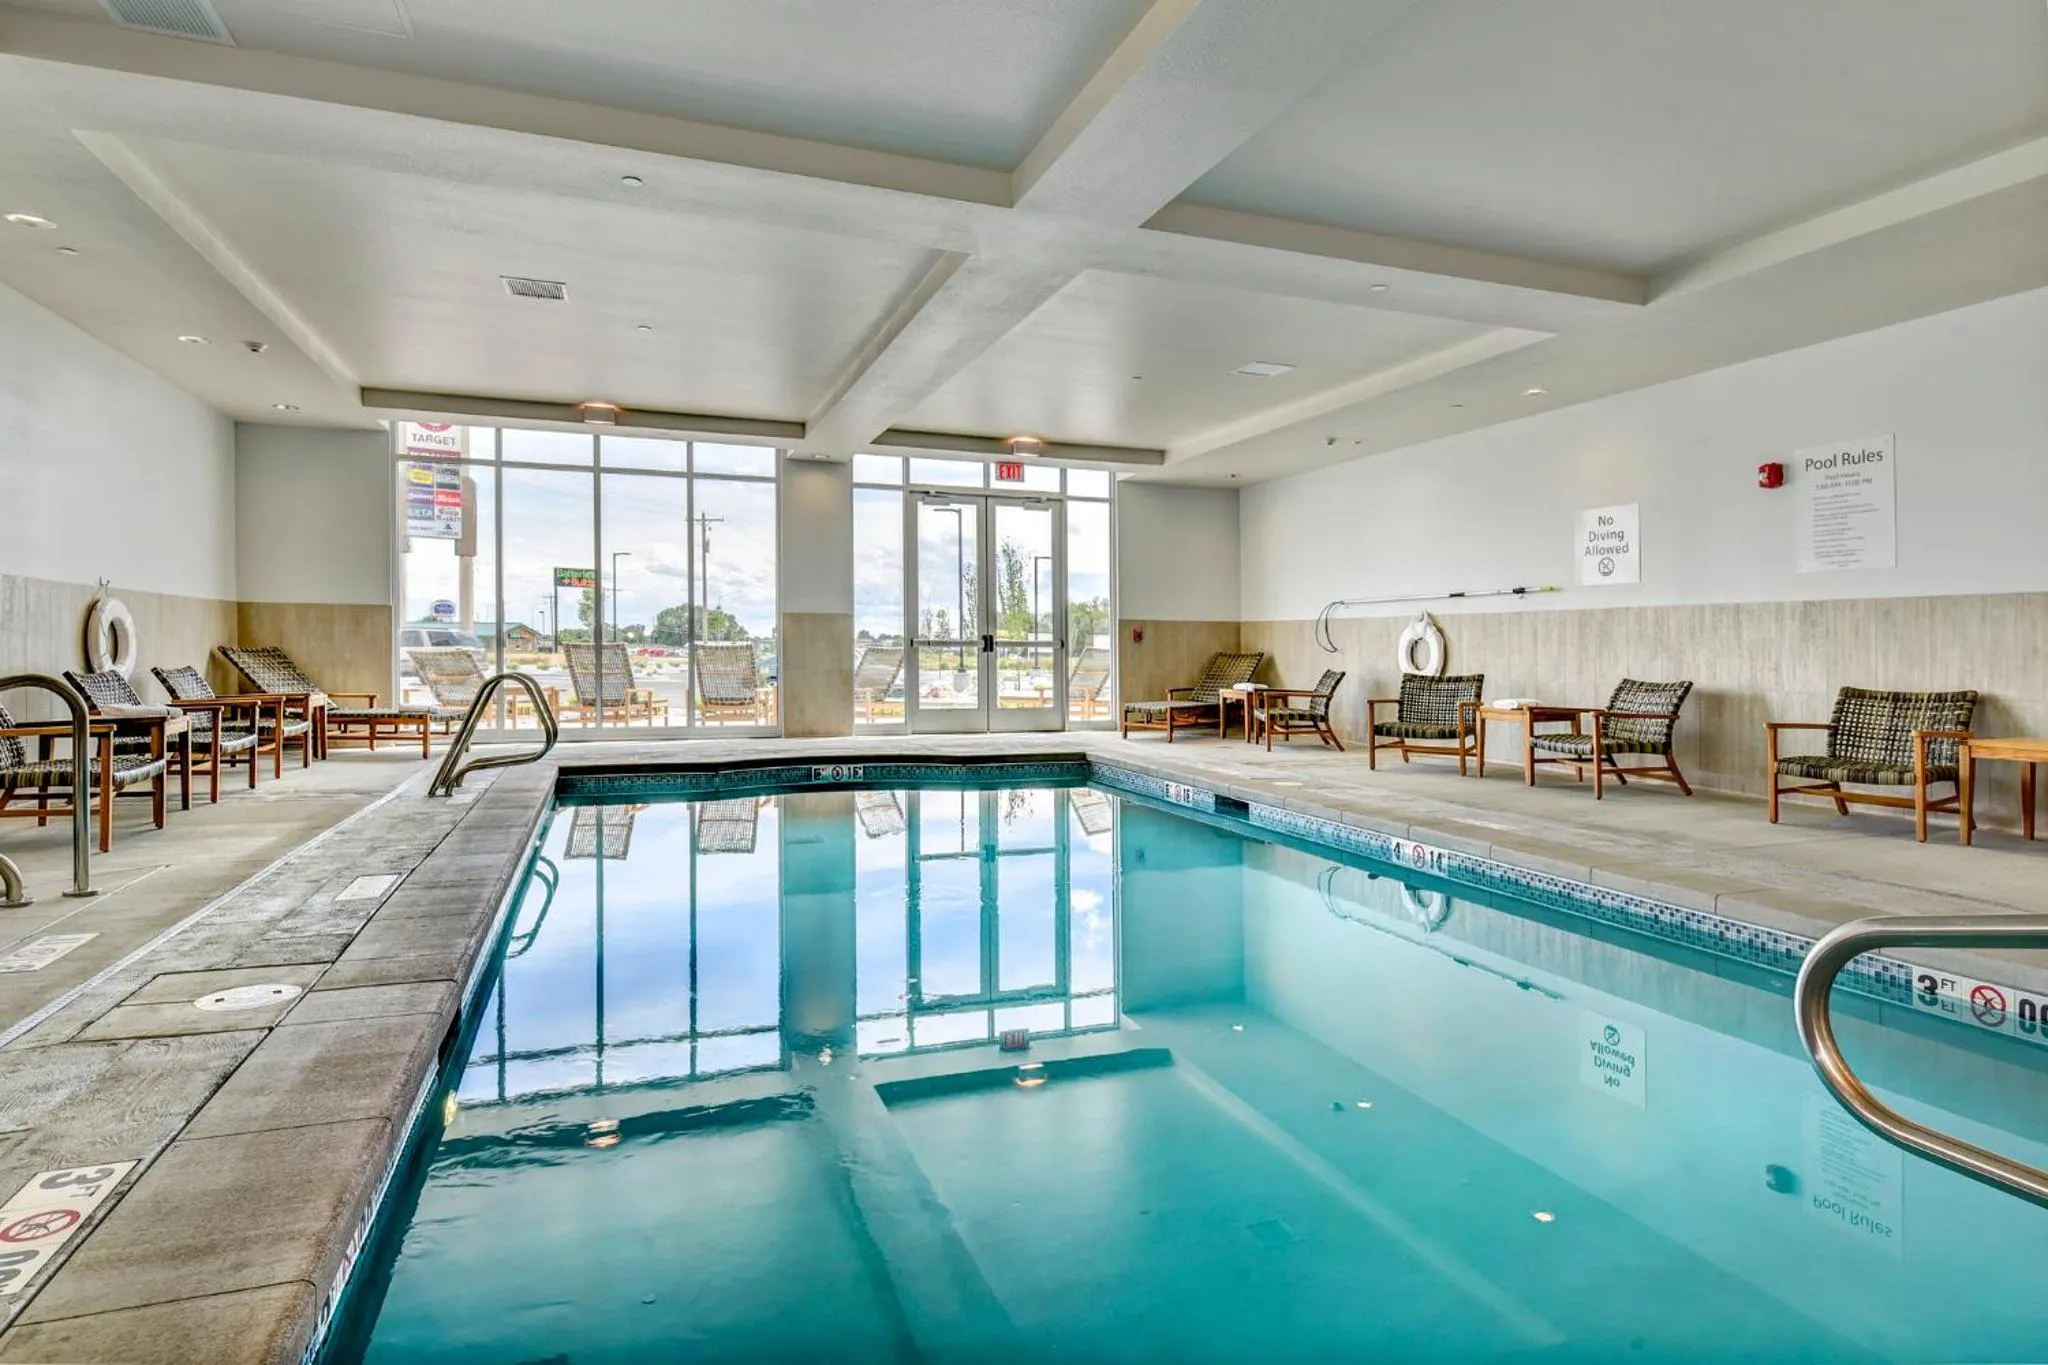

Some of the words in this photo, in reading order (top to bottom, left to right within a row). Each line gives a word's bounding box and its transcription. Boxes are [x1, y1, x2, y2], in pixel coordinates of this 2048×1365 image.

[411, 432, 456, 447] TARGET
[1805, 453, 1837, 472] Pool
[1842, 449, 1884, 466] Rules
[999, 463, 1022, 480] EXIT
[1598, 514, 1614, 526] No
[1588, 529, 1625, 542] Diving
[1584, 541, 1630, 557] Allowed
[1941, 978, 1957, 992] FT
